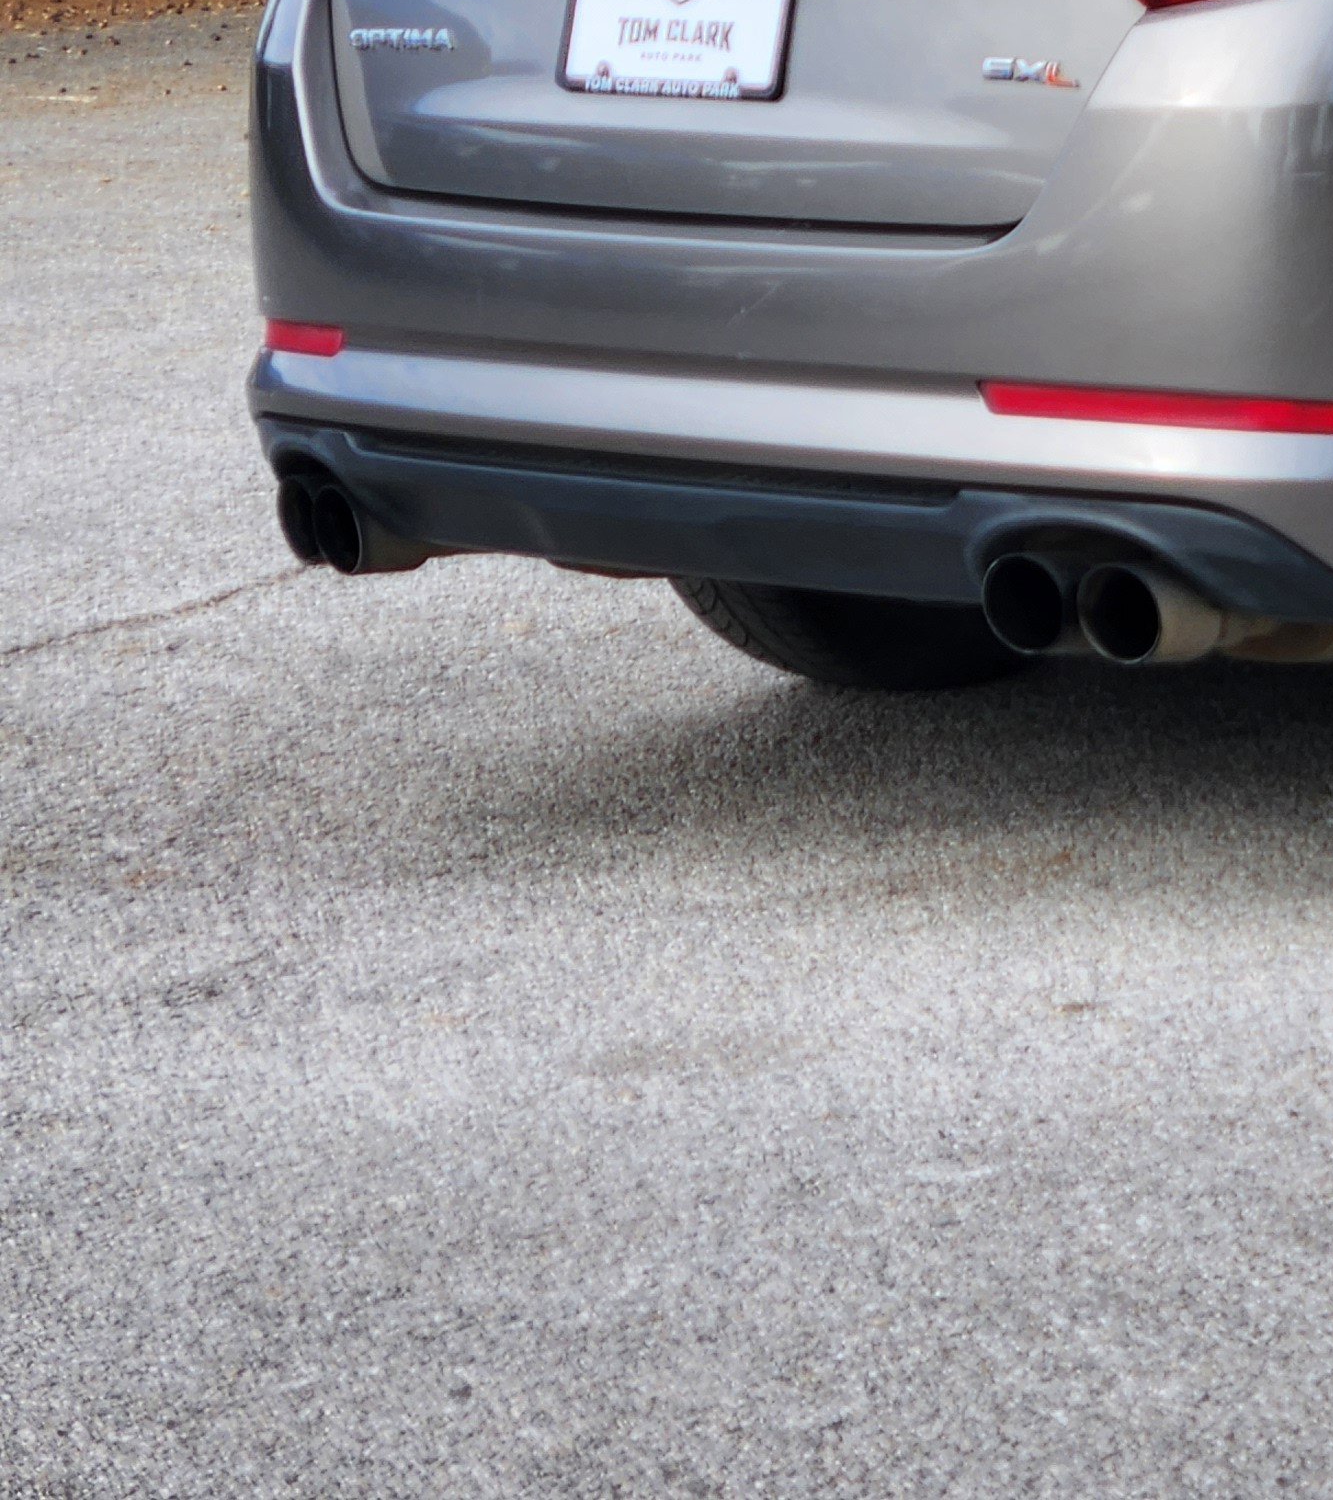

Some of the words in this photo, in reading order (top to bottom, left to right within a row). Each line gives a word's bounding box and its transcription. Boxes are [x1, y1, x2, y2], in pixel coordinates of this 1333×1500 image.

[350, 28, 453, 49] OPTIMA
[618, 16, 660, 46] TOM
[666, 18, 735, 52] CLARK
[982, 56, 1079, 88] SXL
[585, 76, 612, 92] TOM
[616, 79, 660, 96] CLARK
[661, 81, 699, 98] AUTO
[702, 82, 740, 99] PARK
